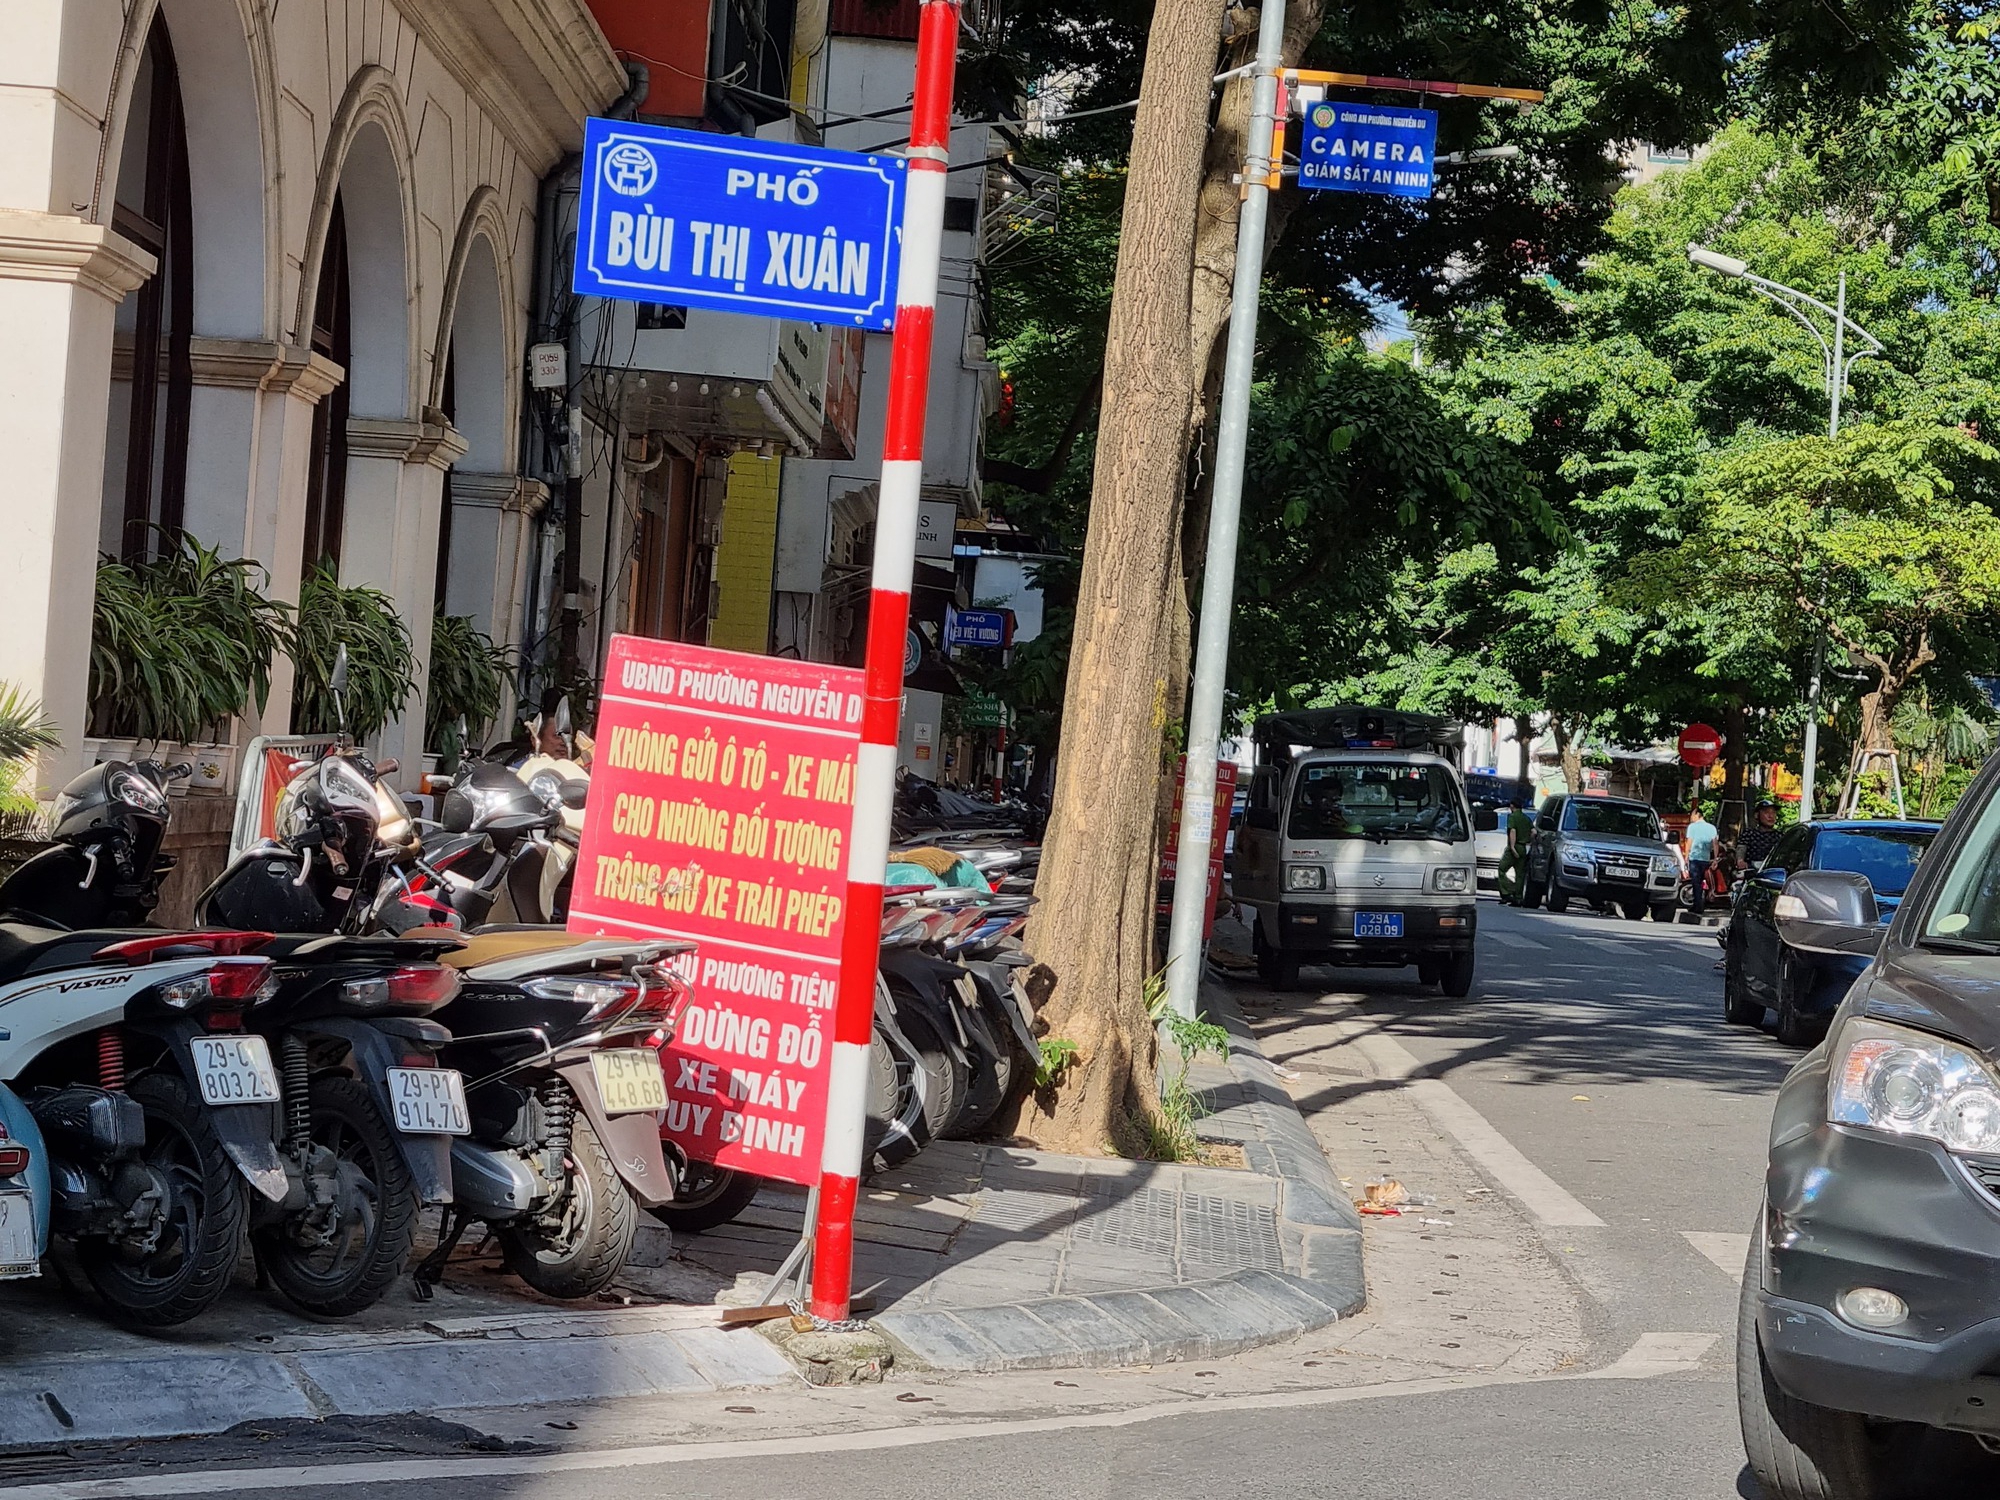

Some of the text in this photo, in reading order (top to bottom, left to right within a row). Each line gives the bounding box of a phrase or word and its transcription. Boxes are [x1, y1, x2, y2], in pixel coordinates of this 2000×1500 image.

[1358, 114, 1367, 124] AN
[1417, 120, 1426, 129] DU
[1310, 136, 1425, 164] CAMERA
[726, 166, 823, 206] PHỐ
[1304, 161, 1429, 188] GIÁM SÁT AN NINH
[607, 203, 870, 296] BÙI THỊ XUÂN
[916, 532, 937, 542] INH
[622, 660, 863, 724] UBND PHƯỜNG NGUYỄN D
[608, 722, 679, 777] KHÔNG
[681, 726, 718, 783] GỬI
[720, 736, 737, 786] Ô
[740, 741, 767, 791] TÔ
[782, 754, 814, 798] XE
[612, 793, 842, 875] CHO NHỮNG ĐỐI TƯỢNG
[594, 850, 662, 905] TRÔNG
[701, 874, 734, 920] XE
[736, 876, 780, 929] TRÁI
[783, 886, 842, 938] PHÉP
[1369, 914, 1390, 924] 29A
[57, 974, 134, 993] VISION
[702, 959, 785, 1000] PHƯƠNG
[790, 972, 836, 1014] TIỆN
[682, 1002, 770, 1055] DỪNG
[778, 1014, 822, 1069] ĐỖ
[204, 1042, 253, 1068] 29-C
[604, 1052, 650, 1079] 29-F1
[400, 1072, 451, 1100] 29-P1
[606, 1080, 662, 1108] 448.68
[674, 1058, 807, 1112] XE MÁY
[720, 1110, 806, 1158] ĐỊNH
